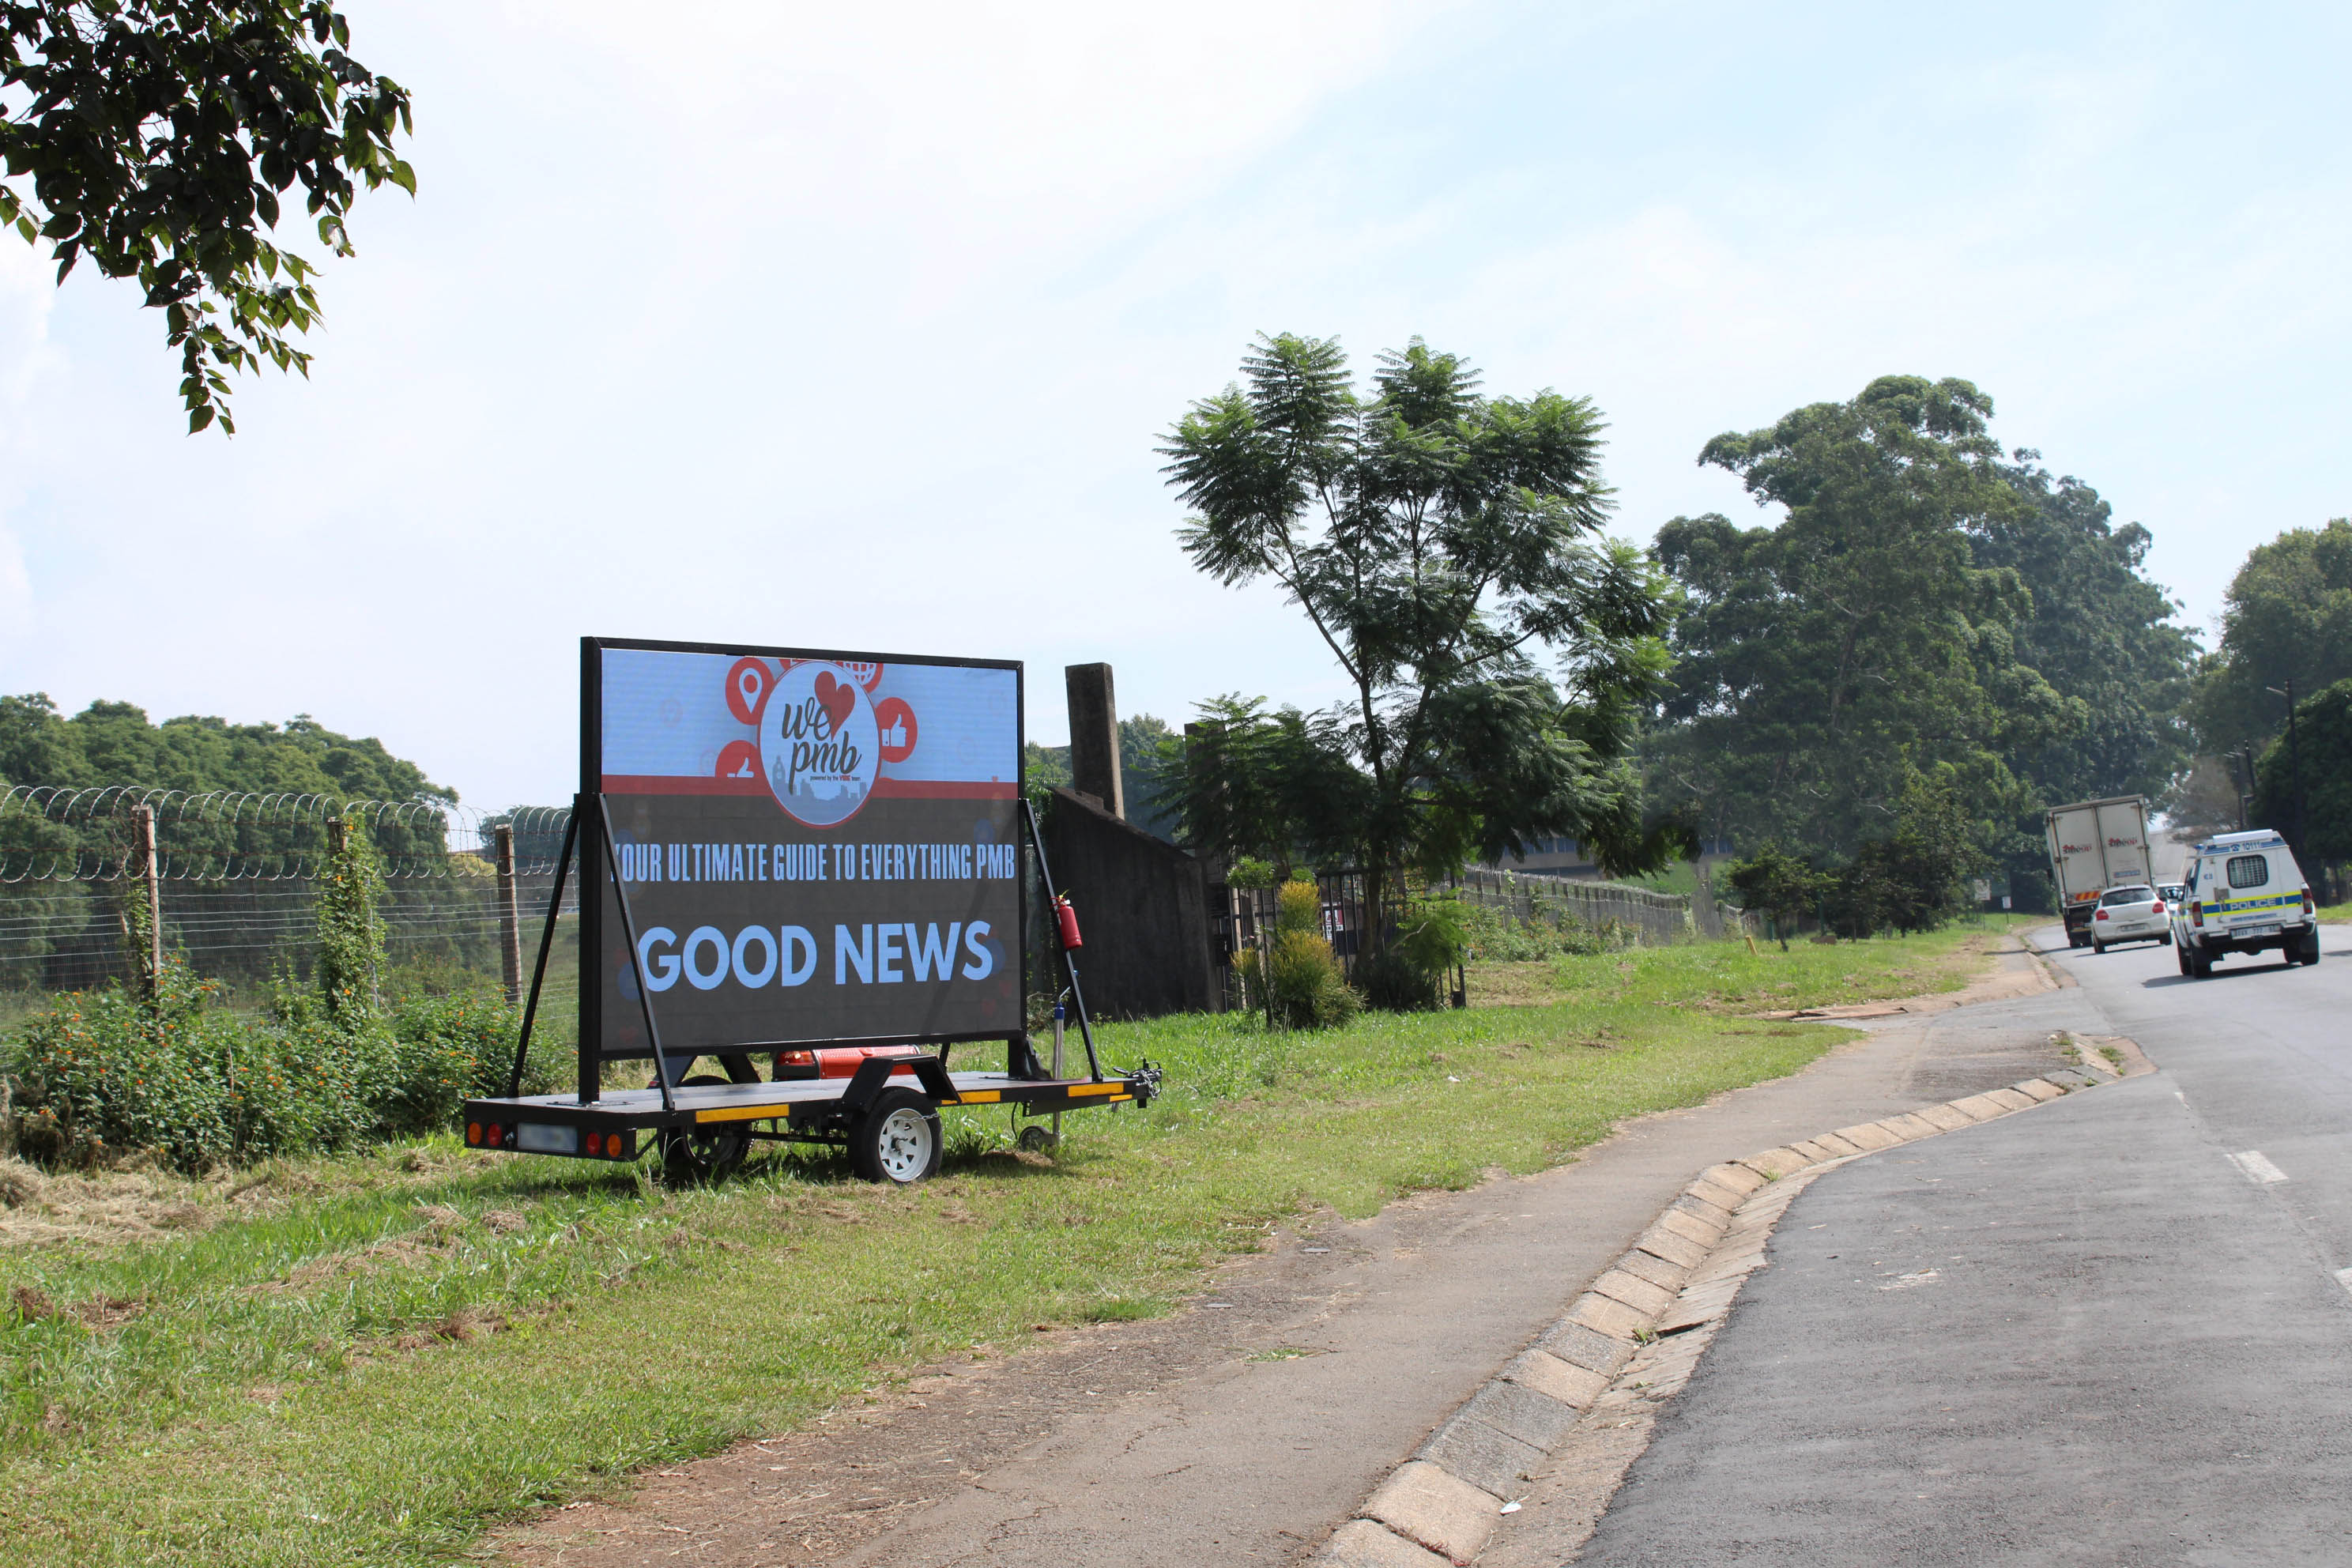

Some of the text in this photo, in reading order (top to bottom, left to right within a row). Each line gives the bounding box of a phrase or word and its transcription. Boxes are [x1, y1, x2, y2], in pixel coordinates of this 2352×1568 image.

[782, 696, 832, 741] we
[789, 730, 862, 795] pmb
[668, 843, 767, 882] ULTIMATE
[773, 843, 827, 881] GUIDE
[832, 843, 856, 880] TO
[861, 843, 971, 880] EVERYTHING
[976, 843, 1015, 880] PMB
[2242, 841, 2260, 850] 10111
[2230, 897, 2276, 911] POLICE
[637, 920, 993, 993] GOOD NEWS
